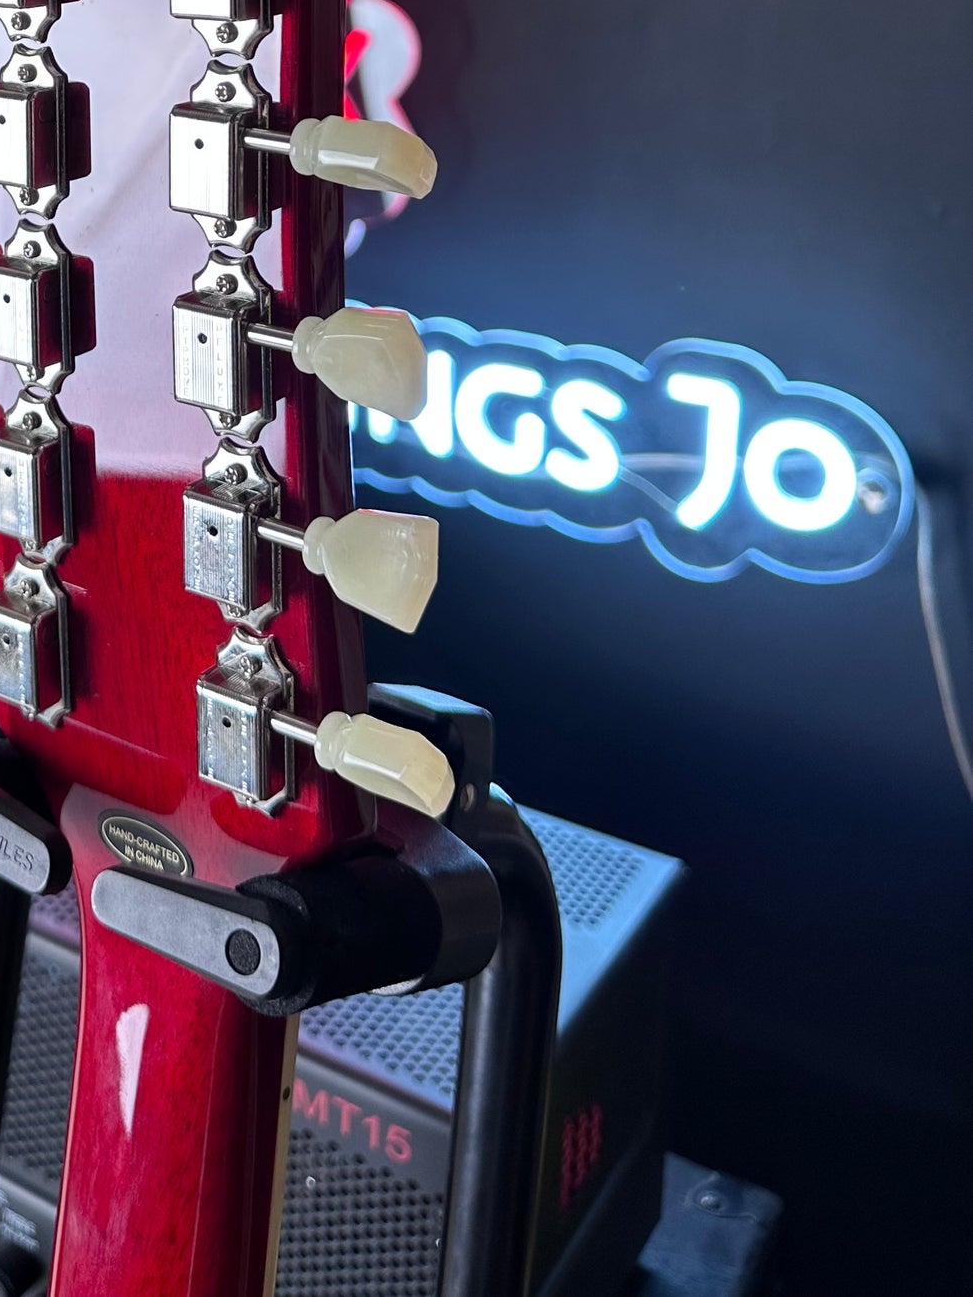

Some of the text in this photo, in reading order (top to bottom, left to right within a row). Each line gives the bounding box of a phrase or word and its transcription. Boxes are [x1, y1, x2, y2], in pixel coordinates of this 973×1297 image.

[348, 348, 627, 493] NGS
[108, 823, 180, 863] HAND-CRAFTED
[124, 844, 165, 871] IN CHINA
[292, 1077, 413, 1163] MT15
